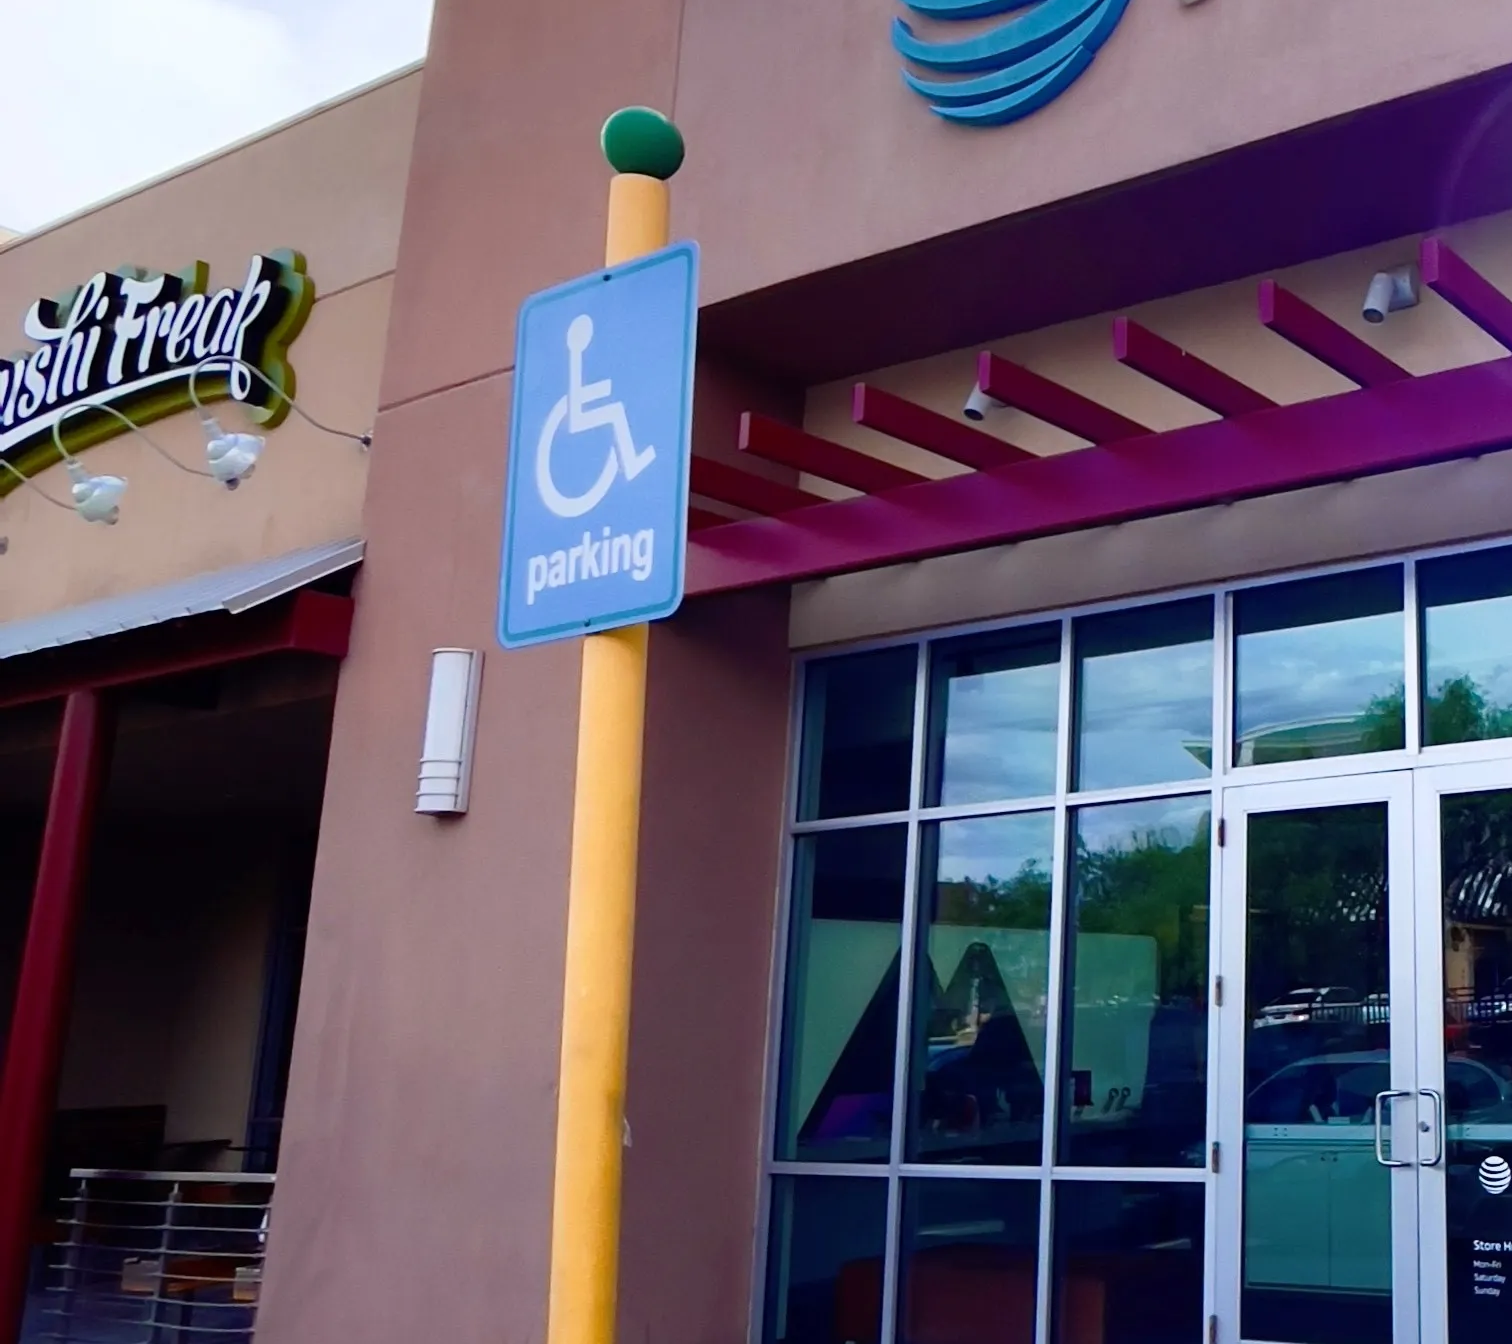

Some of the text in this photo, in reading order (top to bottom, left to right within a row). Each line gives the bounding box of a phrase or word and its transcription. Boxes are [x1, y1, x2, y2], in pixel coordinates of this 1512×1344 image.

[0, 254, 271, 426] ushi Freak
[527, 527, 655, 605] parking
[1473, 1239, 1501, 1251] Store
[1474, 1273, 1506, 1284] Saturday
[1474, 1286, 1501, 1297] Sunday
